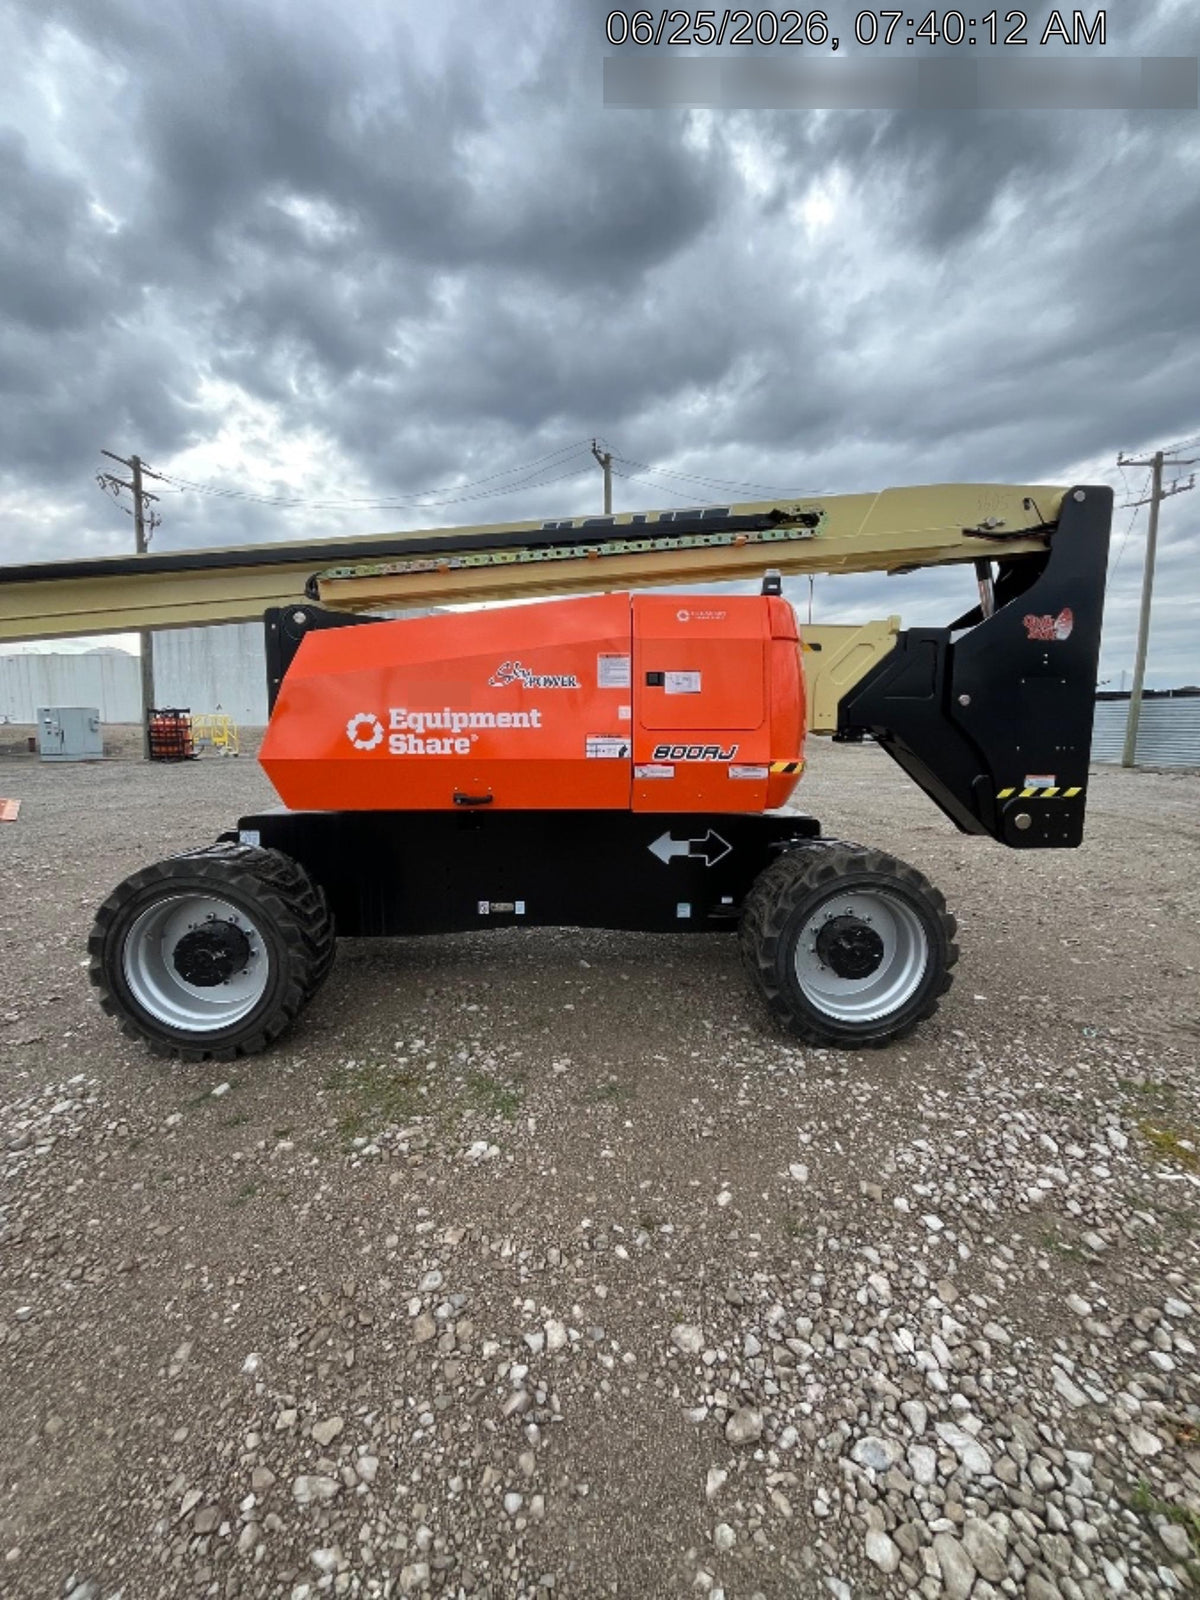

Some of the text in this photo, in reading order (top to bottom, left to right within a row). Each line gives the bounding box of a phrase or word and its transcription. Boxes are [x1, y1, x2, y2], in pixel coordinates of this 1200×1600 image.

[527, 674, 580, 688] POWER
[389, 707, 542, 733] Equipment
[652, 744, 739, 761] 800AJ
